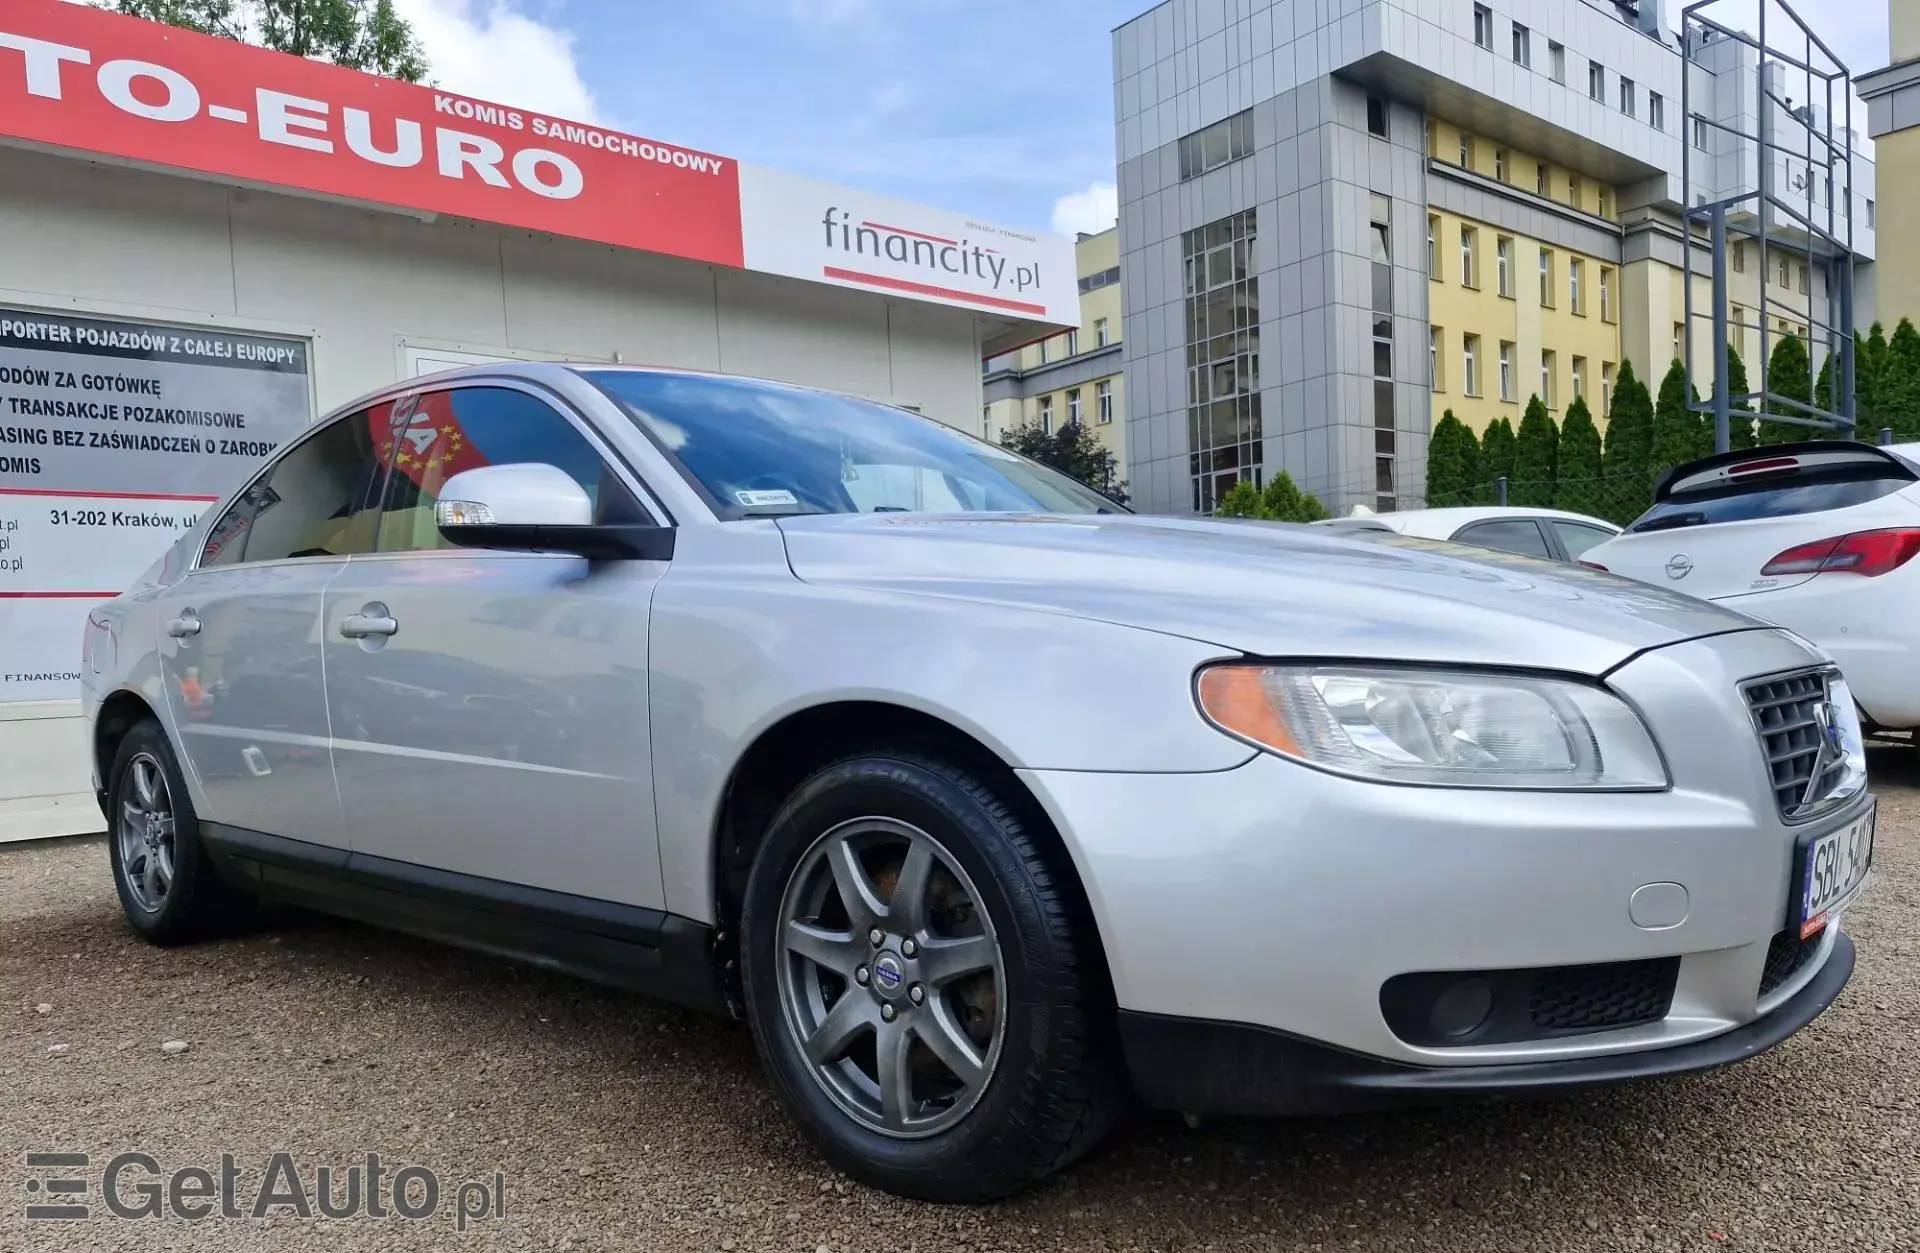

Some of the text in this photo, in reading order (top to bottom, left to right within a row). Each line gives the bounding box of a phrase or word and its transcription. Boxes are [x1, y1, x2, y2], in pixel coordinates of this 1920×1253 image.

[434, 94, 723, 176] KOMIS SAMOCHODOWY
[822, 206, 1041, 292] financity.pl
[0, 320, 296, 364] PORTER POJAZDÓW Z CAŁEJ EUROPY
[55, 371, 77, 389] ZA
[81, 373, 161, 399] GOTÓWKĘ
[8, 397, 246, 429] TRANSAKCJE POZAKOMISOWE
[53, 429, 86, 447] BEZ
[89, 430, 201, 454] ZAŚWIADCZEŃ
[205, 439, 216, 454] O
[50, 510, 107, 526] 31-202
[112, 511, 178, 529] Kraków,
[1811, 835, 1840, 908] SBL
